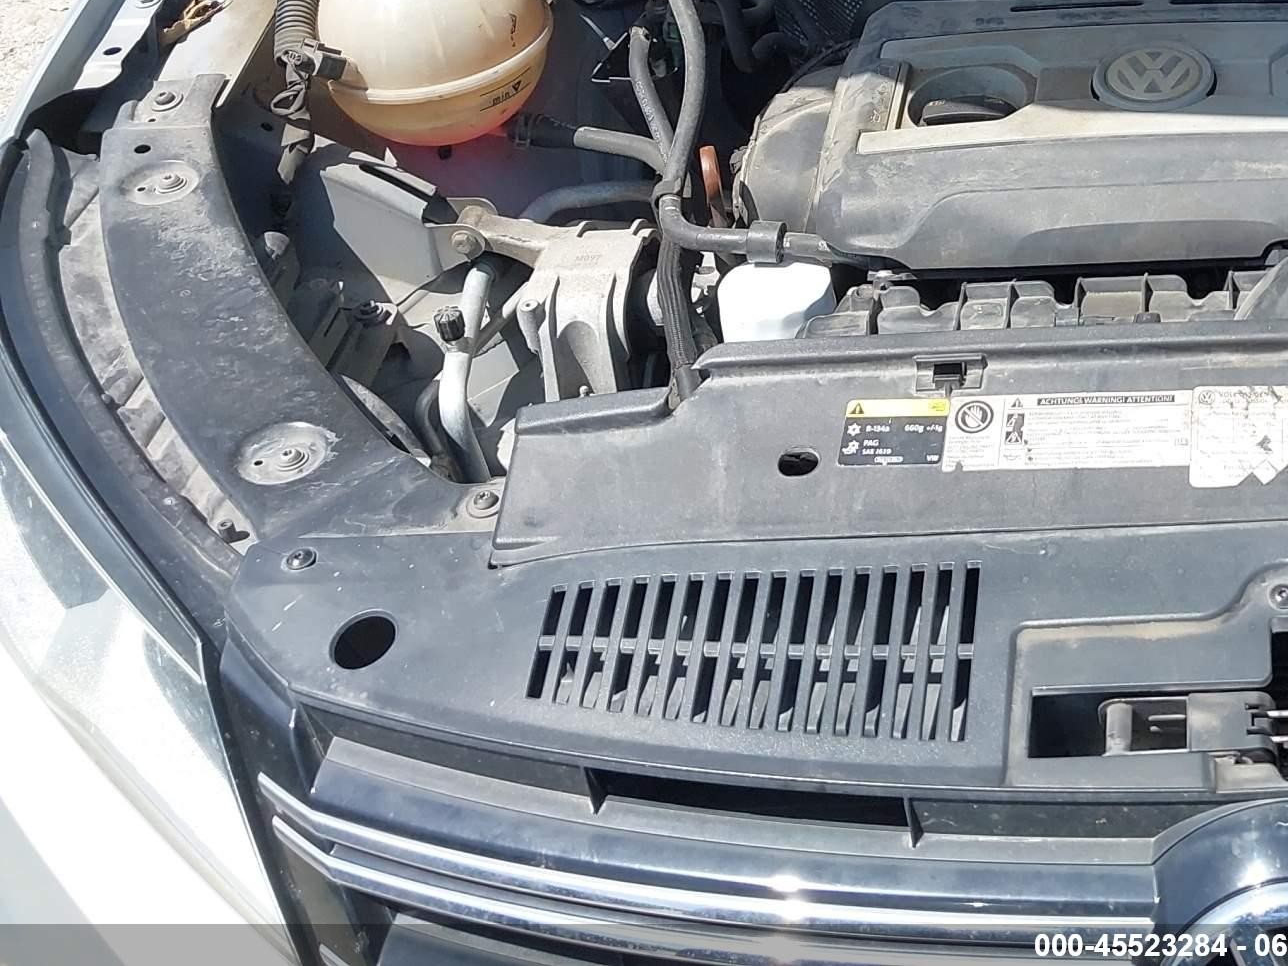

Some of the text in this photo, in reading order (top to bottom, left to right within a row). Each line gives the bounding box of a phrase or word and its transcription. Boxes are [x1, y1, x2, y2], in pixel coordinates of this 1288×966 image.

[493, 92, 510, 106] min
[1084, 396, 1125, 404] WARNING!
[1126, 395, 1173, 403] ATTENTION!
[865, 424, 891, 433] R-134a
[863, 439, 879, 447] PAG
